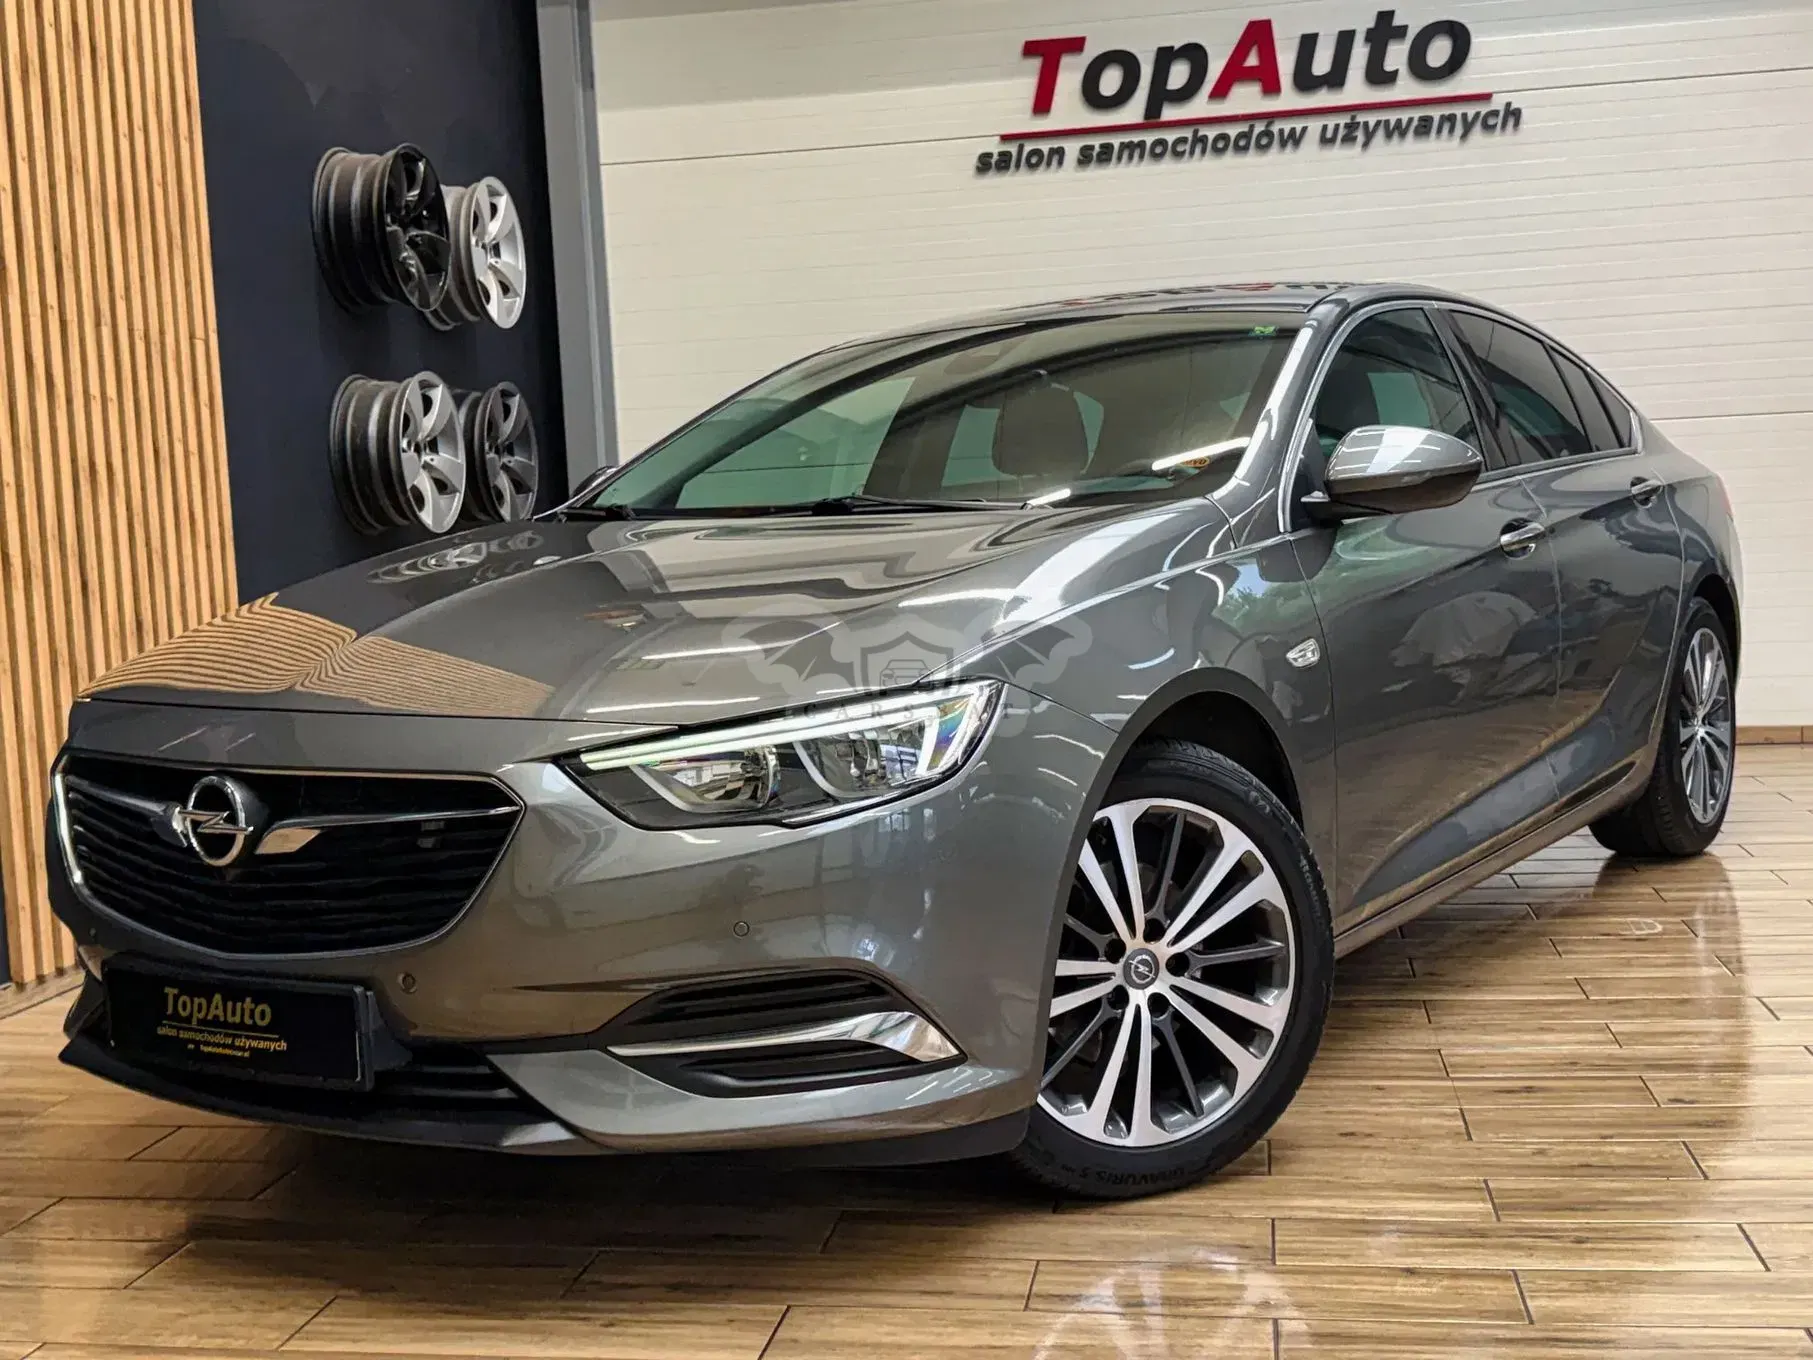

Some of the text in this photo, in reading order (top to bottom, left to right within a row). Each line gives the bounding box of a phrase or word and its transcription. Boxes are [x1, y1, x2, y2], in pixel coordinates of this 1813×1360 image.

[1022, 9, 1472, 121] TopAuto
[974, 102, 1523, 175] salon samochodów używanych
[164, 987, 271, 1027] TopAuto
[178, 1030, 232, 1044] samochodów
[234, 1037, 287, 1052] używanych
